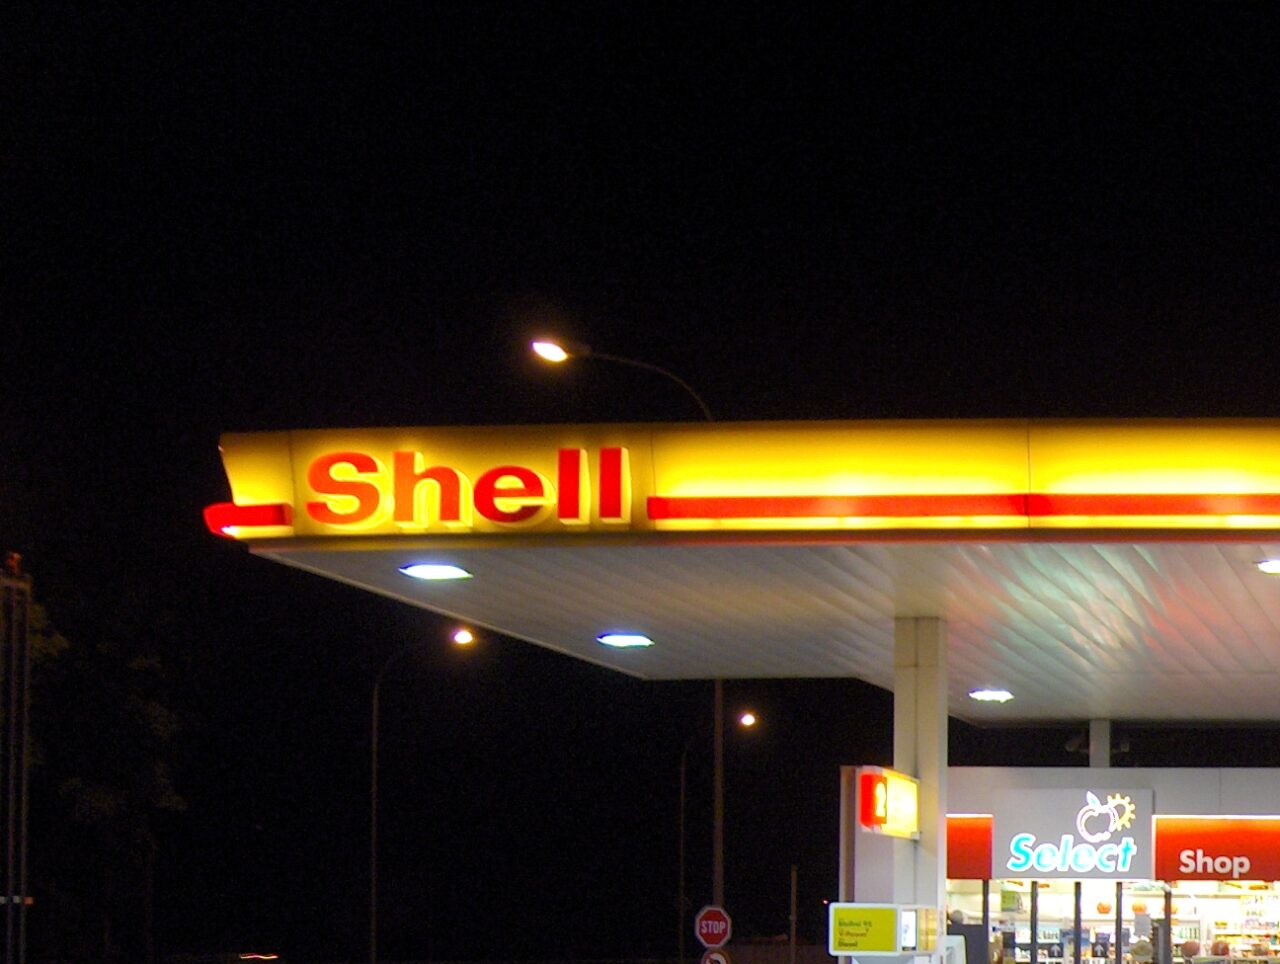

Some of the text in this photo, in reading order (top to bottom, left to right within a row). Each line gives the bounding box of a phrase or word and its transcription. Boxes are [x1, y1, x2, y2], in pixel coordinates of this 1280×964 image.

[306, 447, 627, 527] Shell
[1007, 833, 1138, 873] Select
[1179, 848, 1251, 879] Shop
[701, 920, 727, 934] STOP
